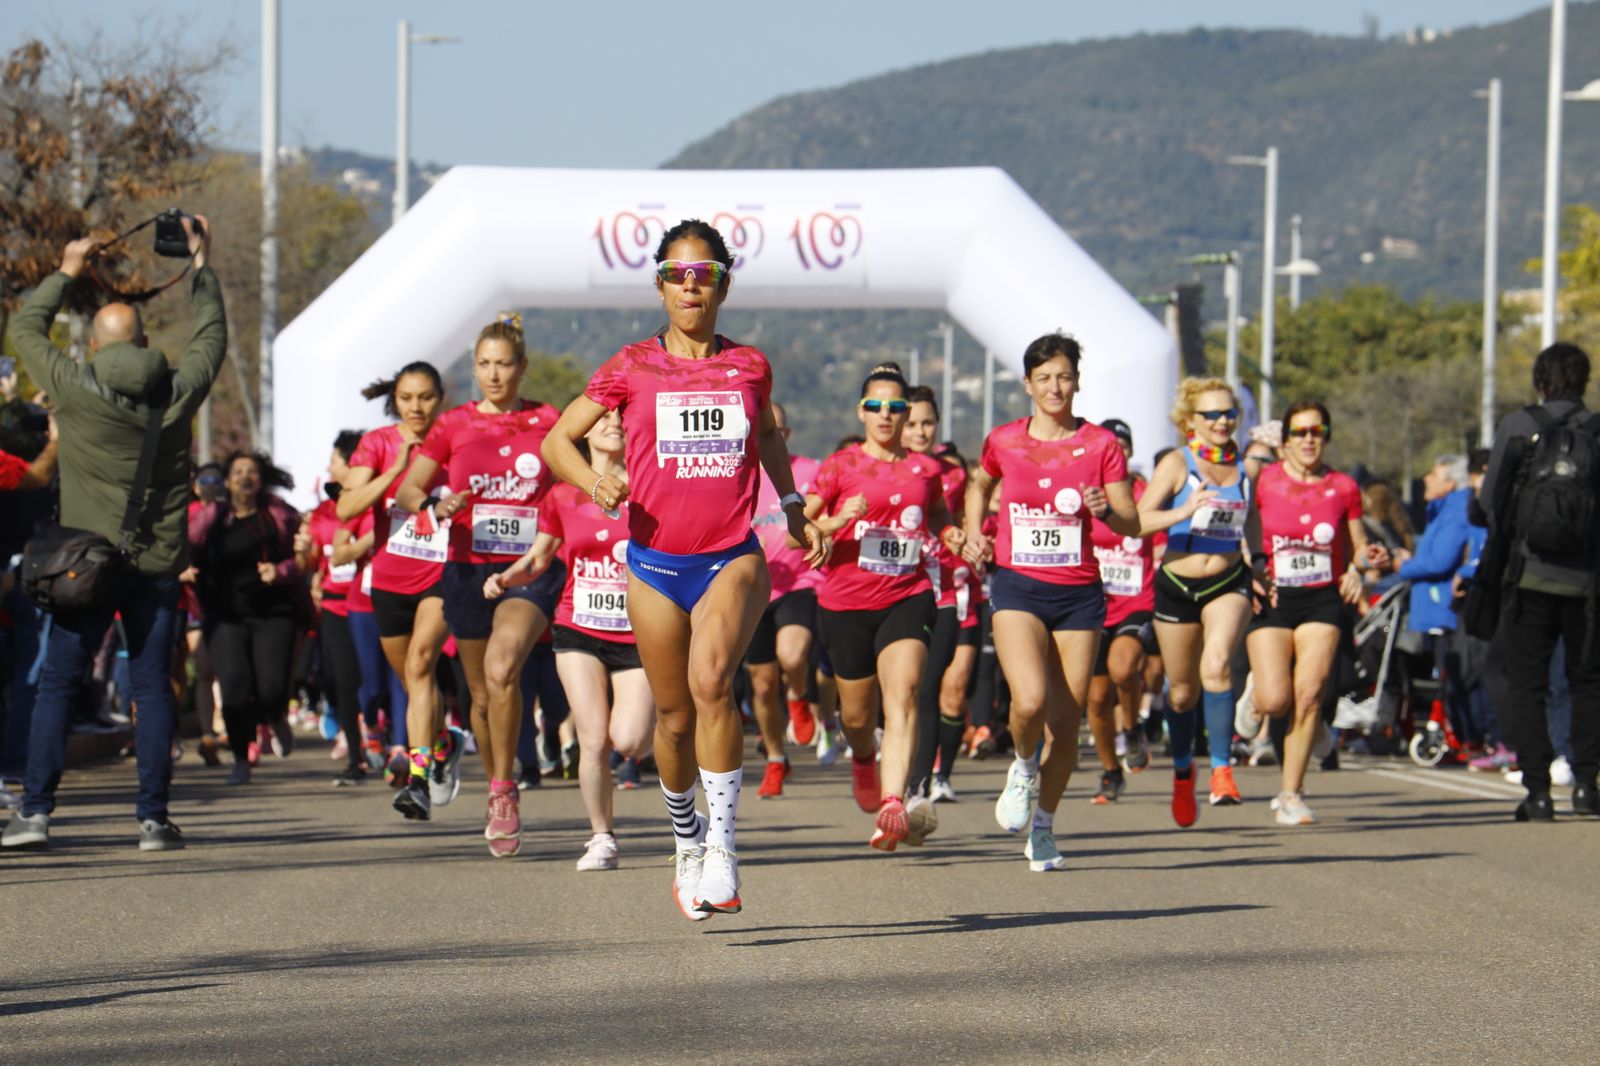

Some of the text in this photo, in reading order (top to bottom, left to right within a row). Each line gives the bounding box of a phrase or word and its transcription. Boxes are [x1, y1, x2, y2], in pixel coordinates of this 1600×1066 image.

[679, 408, 724, 432] 1119
[676, 465, 736, 479] RUNNING
[469, 468, 520, 495] Pink
[1210, 510, 1233, 524] 243
[489, 518, 520, 536] 559
[1031, 529, 1061, 547] 375
[880, 540, 908, 558] 881
[573, 555, 619, 579] Pink
[1291, 555, 1315, 570] 494
[1103, 566, 1132, 580] 1020
[587, 592, 625, 611] 1094
